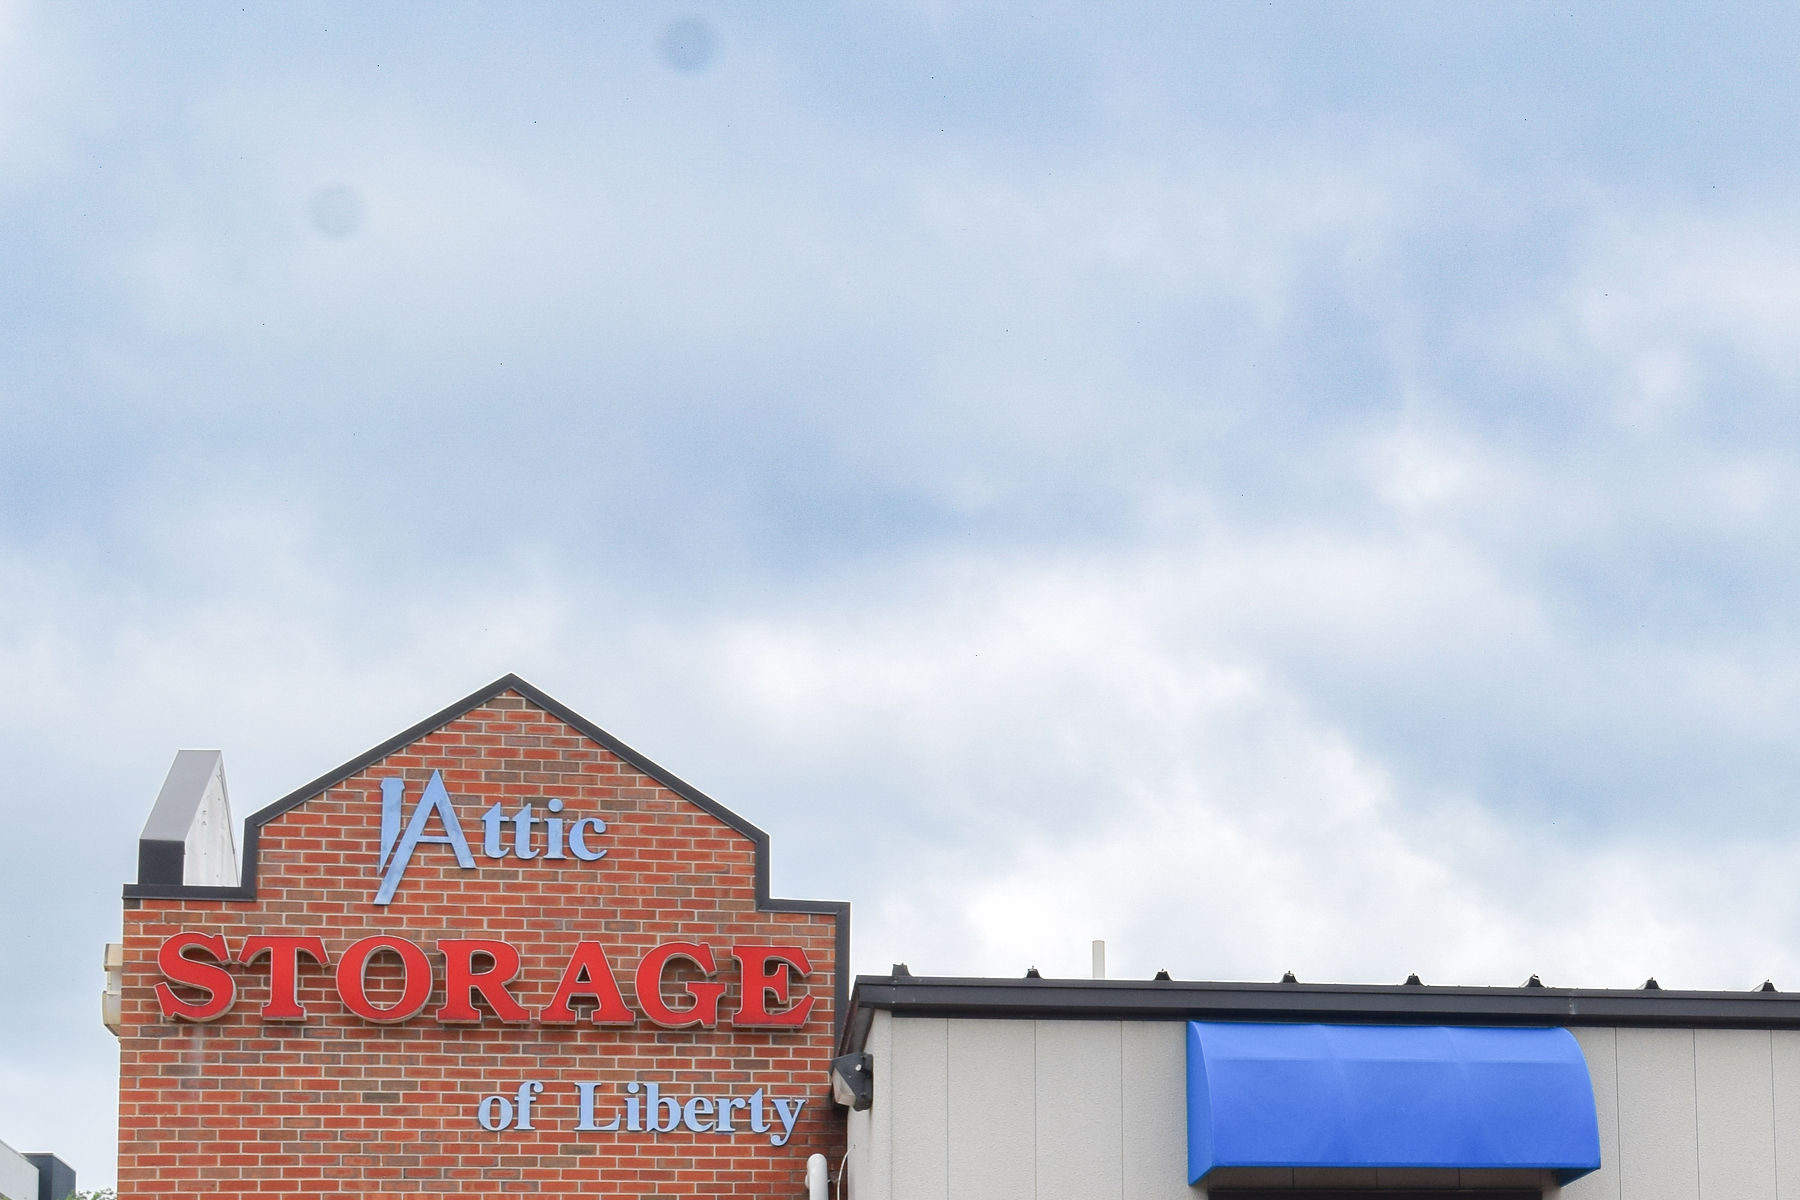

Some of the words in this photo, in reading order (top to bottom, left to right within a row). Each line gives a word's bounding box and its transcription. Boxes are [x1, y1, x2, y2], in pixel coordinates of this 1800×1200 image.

[374, 769, 607, 905] Attic
[154, 931, 817, 1029] STORAGE
[478, 1081, 543, 1132] of
[575, 1082, 806, 1147] Liberty
